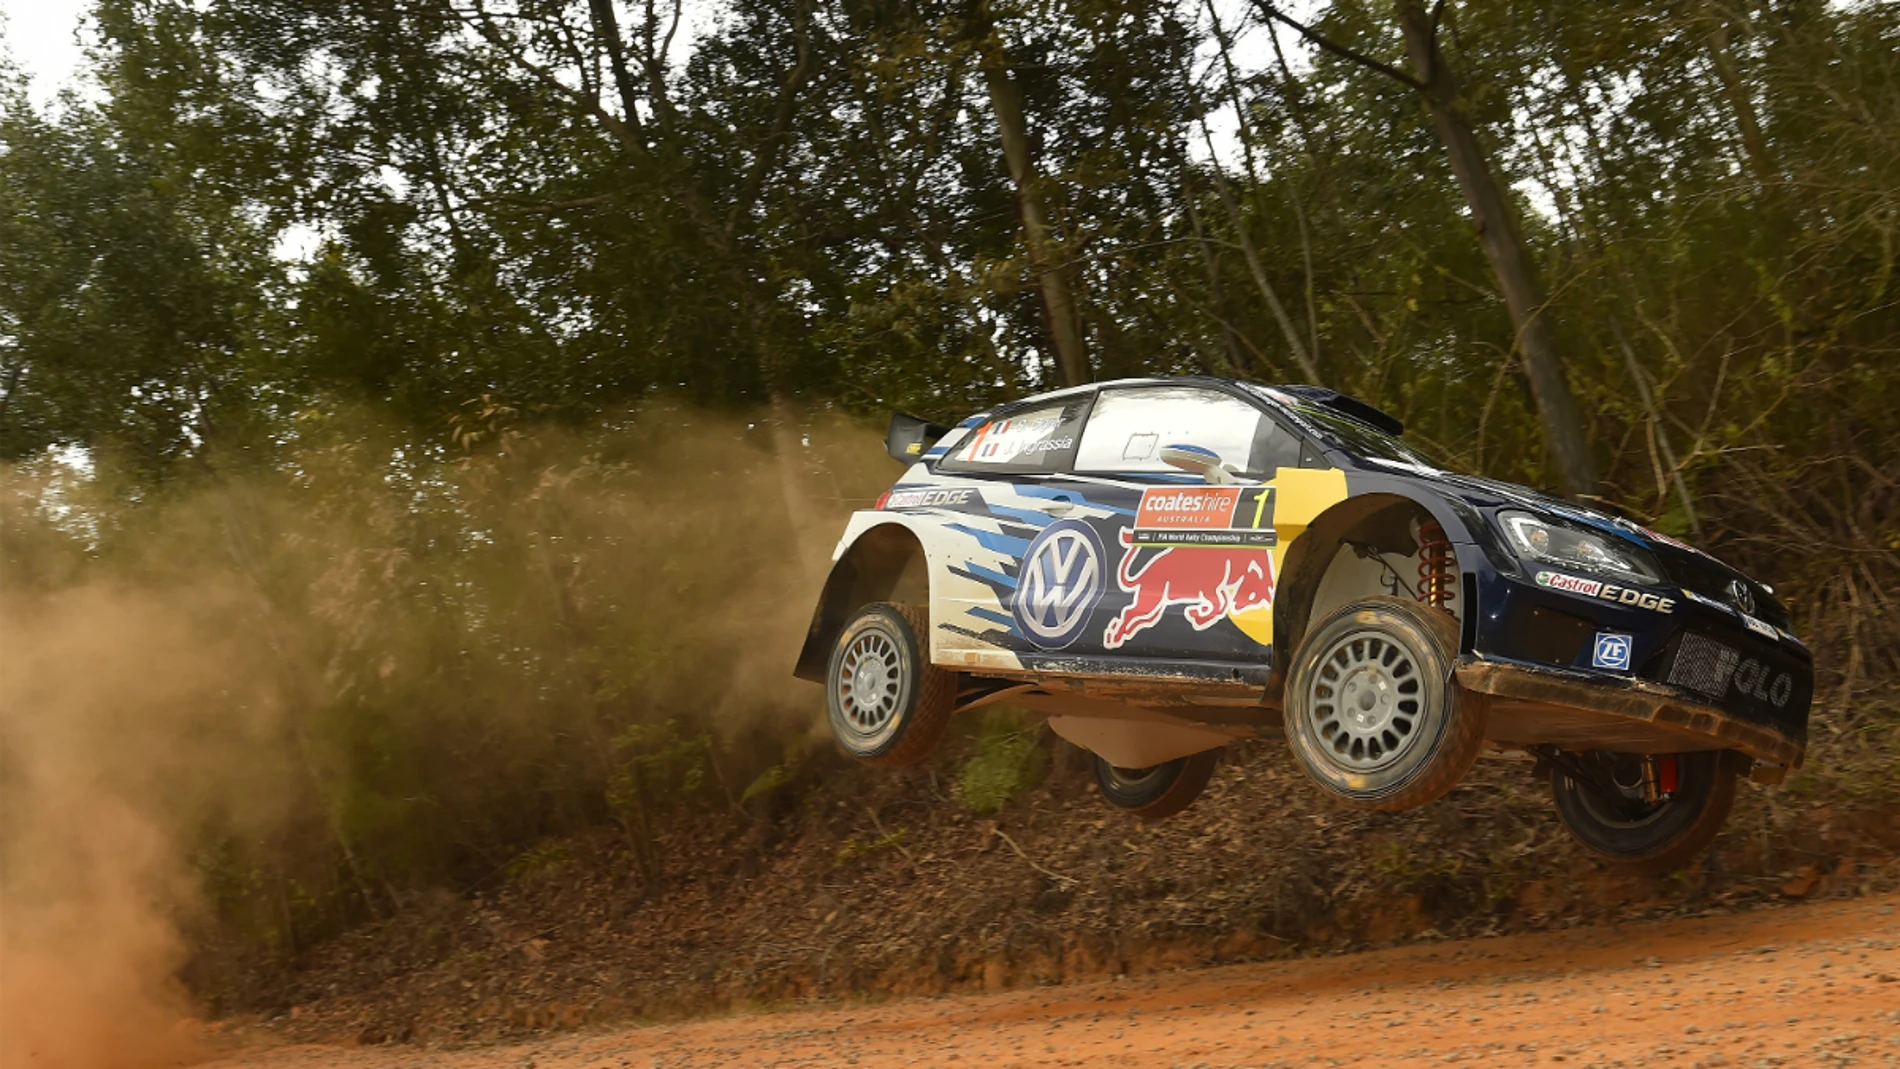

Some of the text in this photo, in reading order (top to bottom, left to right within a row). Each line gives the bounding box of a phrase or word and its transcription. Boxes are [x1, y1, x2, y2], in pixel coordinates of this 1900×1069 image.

[967, 420, 994, 463] 1
[921, 488, 973, 506] EDGE
[1252, 488, 1270, 529] 1
[1156, 515, 1211, 523] AUSTRALIA
[1200, 533, 1241, 542] Championship
[1549, 573, 1599, 595] Castrol
[1599, 584, 1678, 615] EDGE
